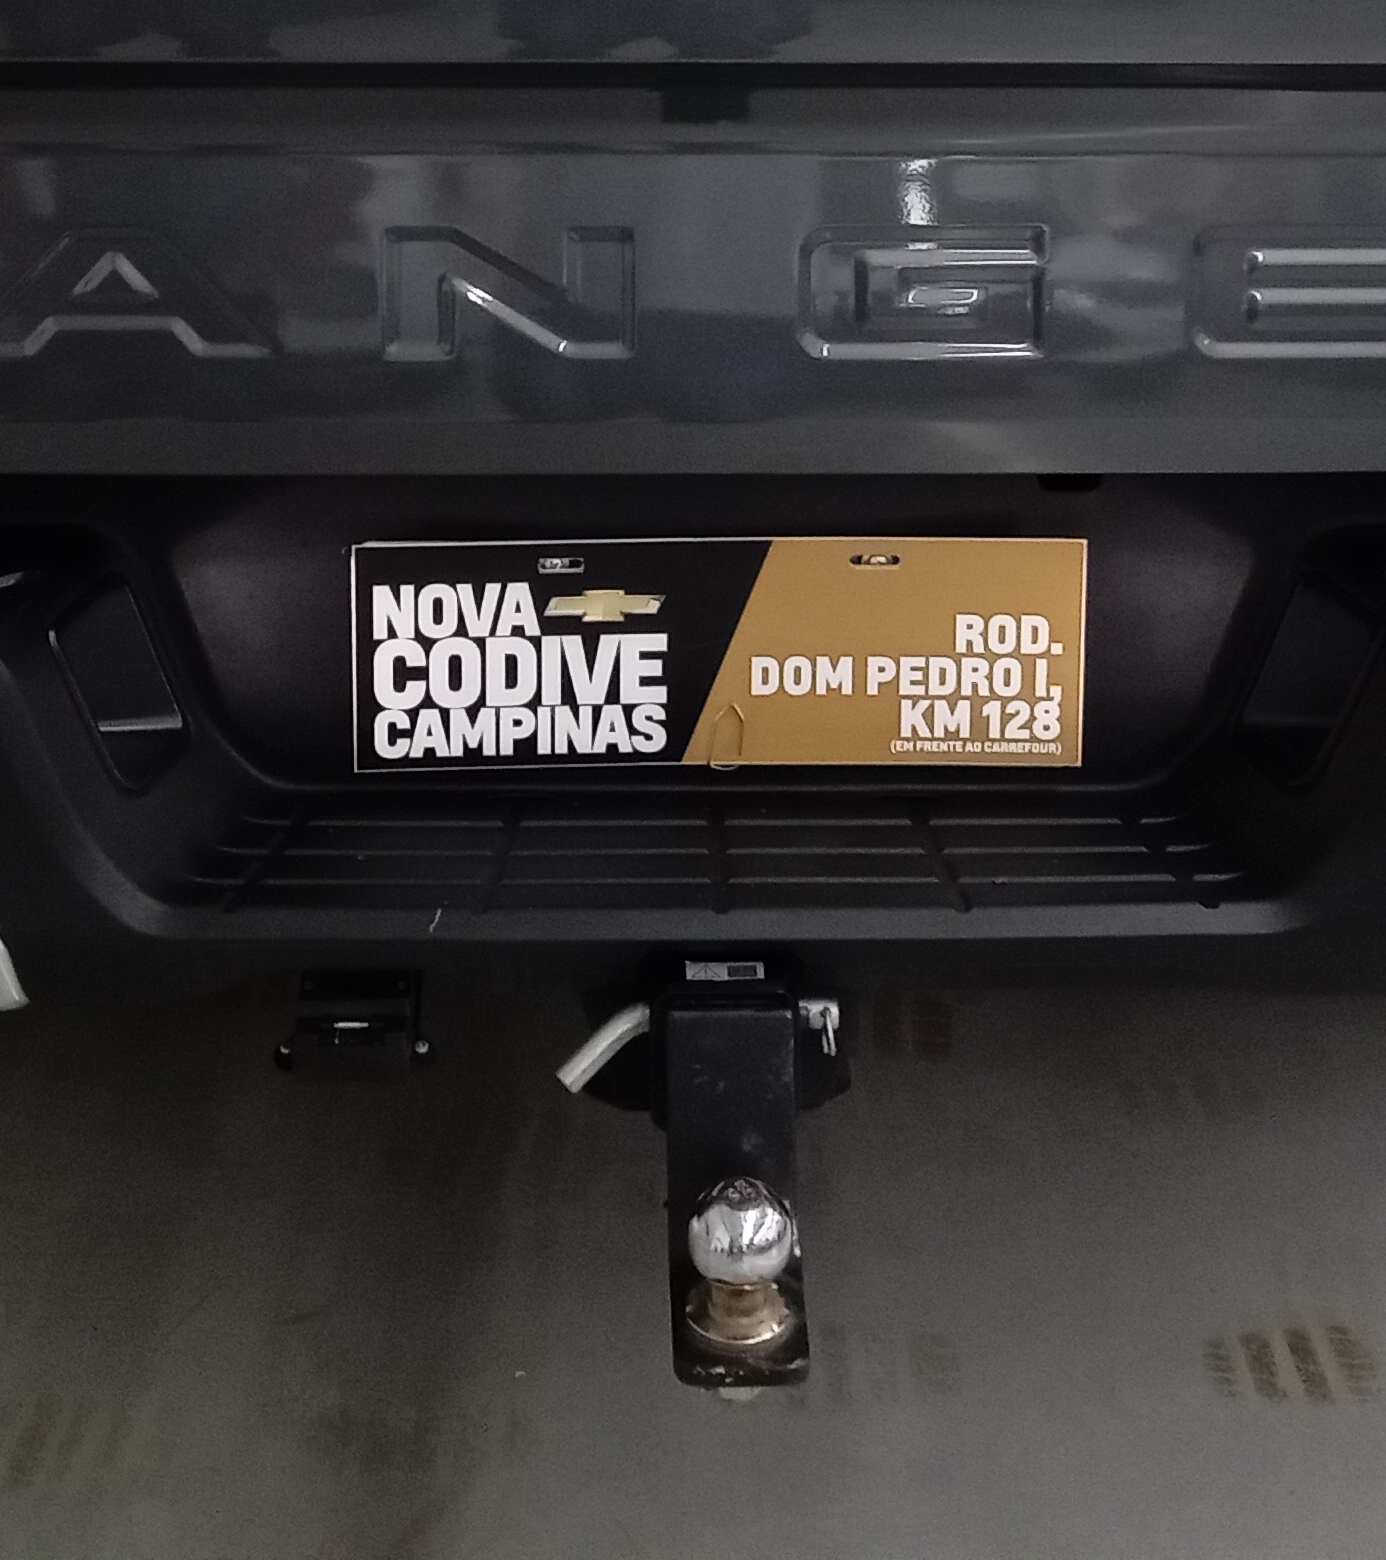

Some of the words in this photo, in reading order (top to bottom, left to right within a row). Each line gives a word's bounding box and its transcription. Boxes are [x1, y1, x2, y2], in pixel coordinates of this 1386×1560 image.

[372, 582, 541, 640] NOVA
[955, 613, 1063, 655] ROD.
[373, 633, 668, 710] CODIVE
[750, 655, 853, 696] DOM
[866, 655, 1023, 697] PEDRO
[1034, 657, 1062, 704] I,
[373, 703, 668, 759] CAMPINAS
[900, 699, 972, 739] KM
[981, 699, 1061, 740] 128
[889, 741, 913, 754] (EM
[916, 741, 963, 753] FRENTE
[965, 741, 982, 753] AO
[984, 741, 1062, 755] CARREFOUR)
